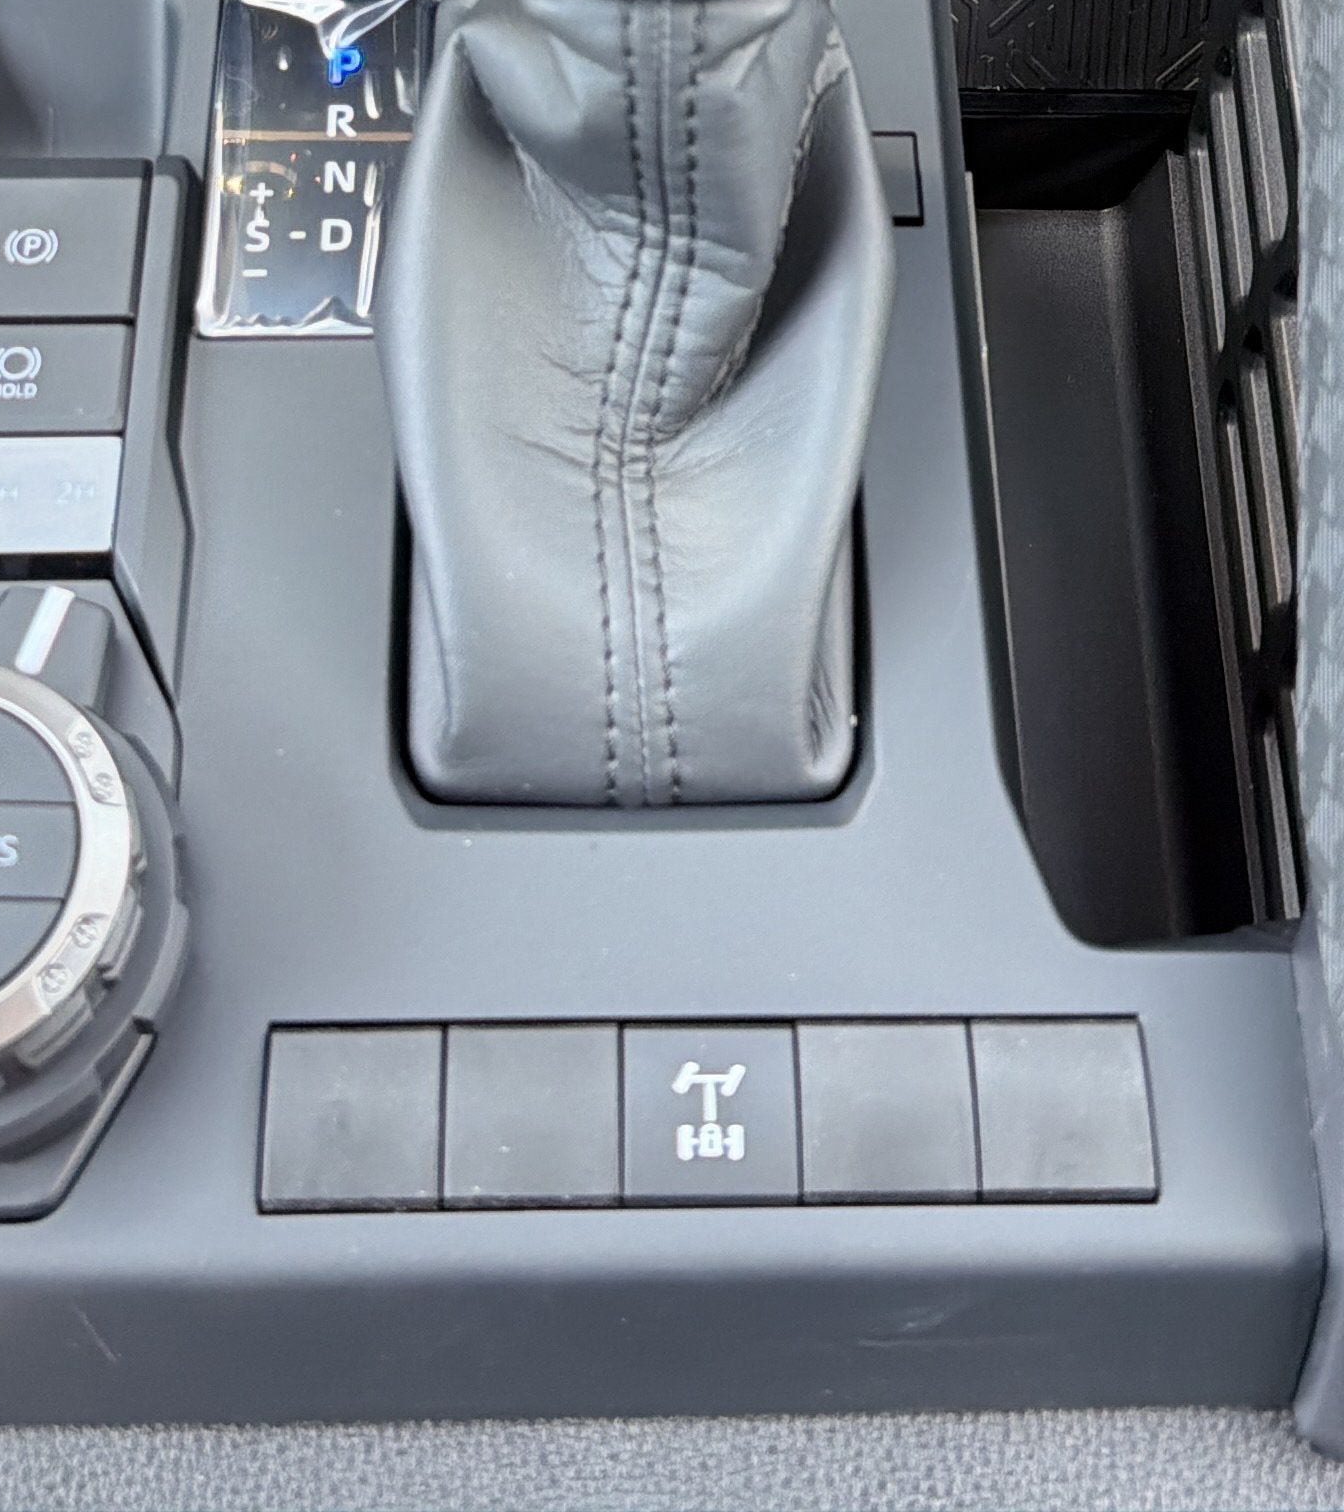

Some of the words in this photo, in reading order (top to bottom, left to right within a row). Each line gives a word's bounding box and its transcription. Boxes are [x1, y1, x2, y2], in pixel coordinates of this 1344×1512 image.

[327, 45, 365, 88] P
[327, 104, 358, 138] R
[324, 160, 356, 193] N
[245, 220, 270, 253] S
[320, 218, 353, 252] D
